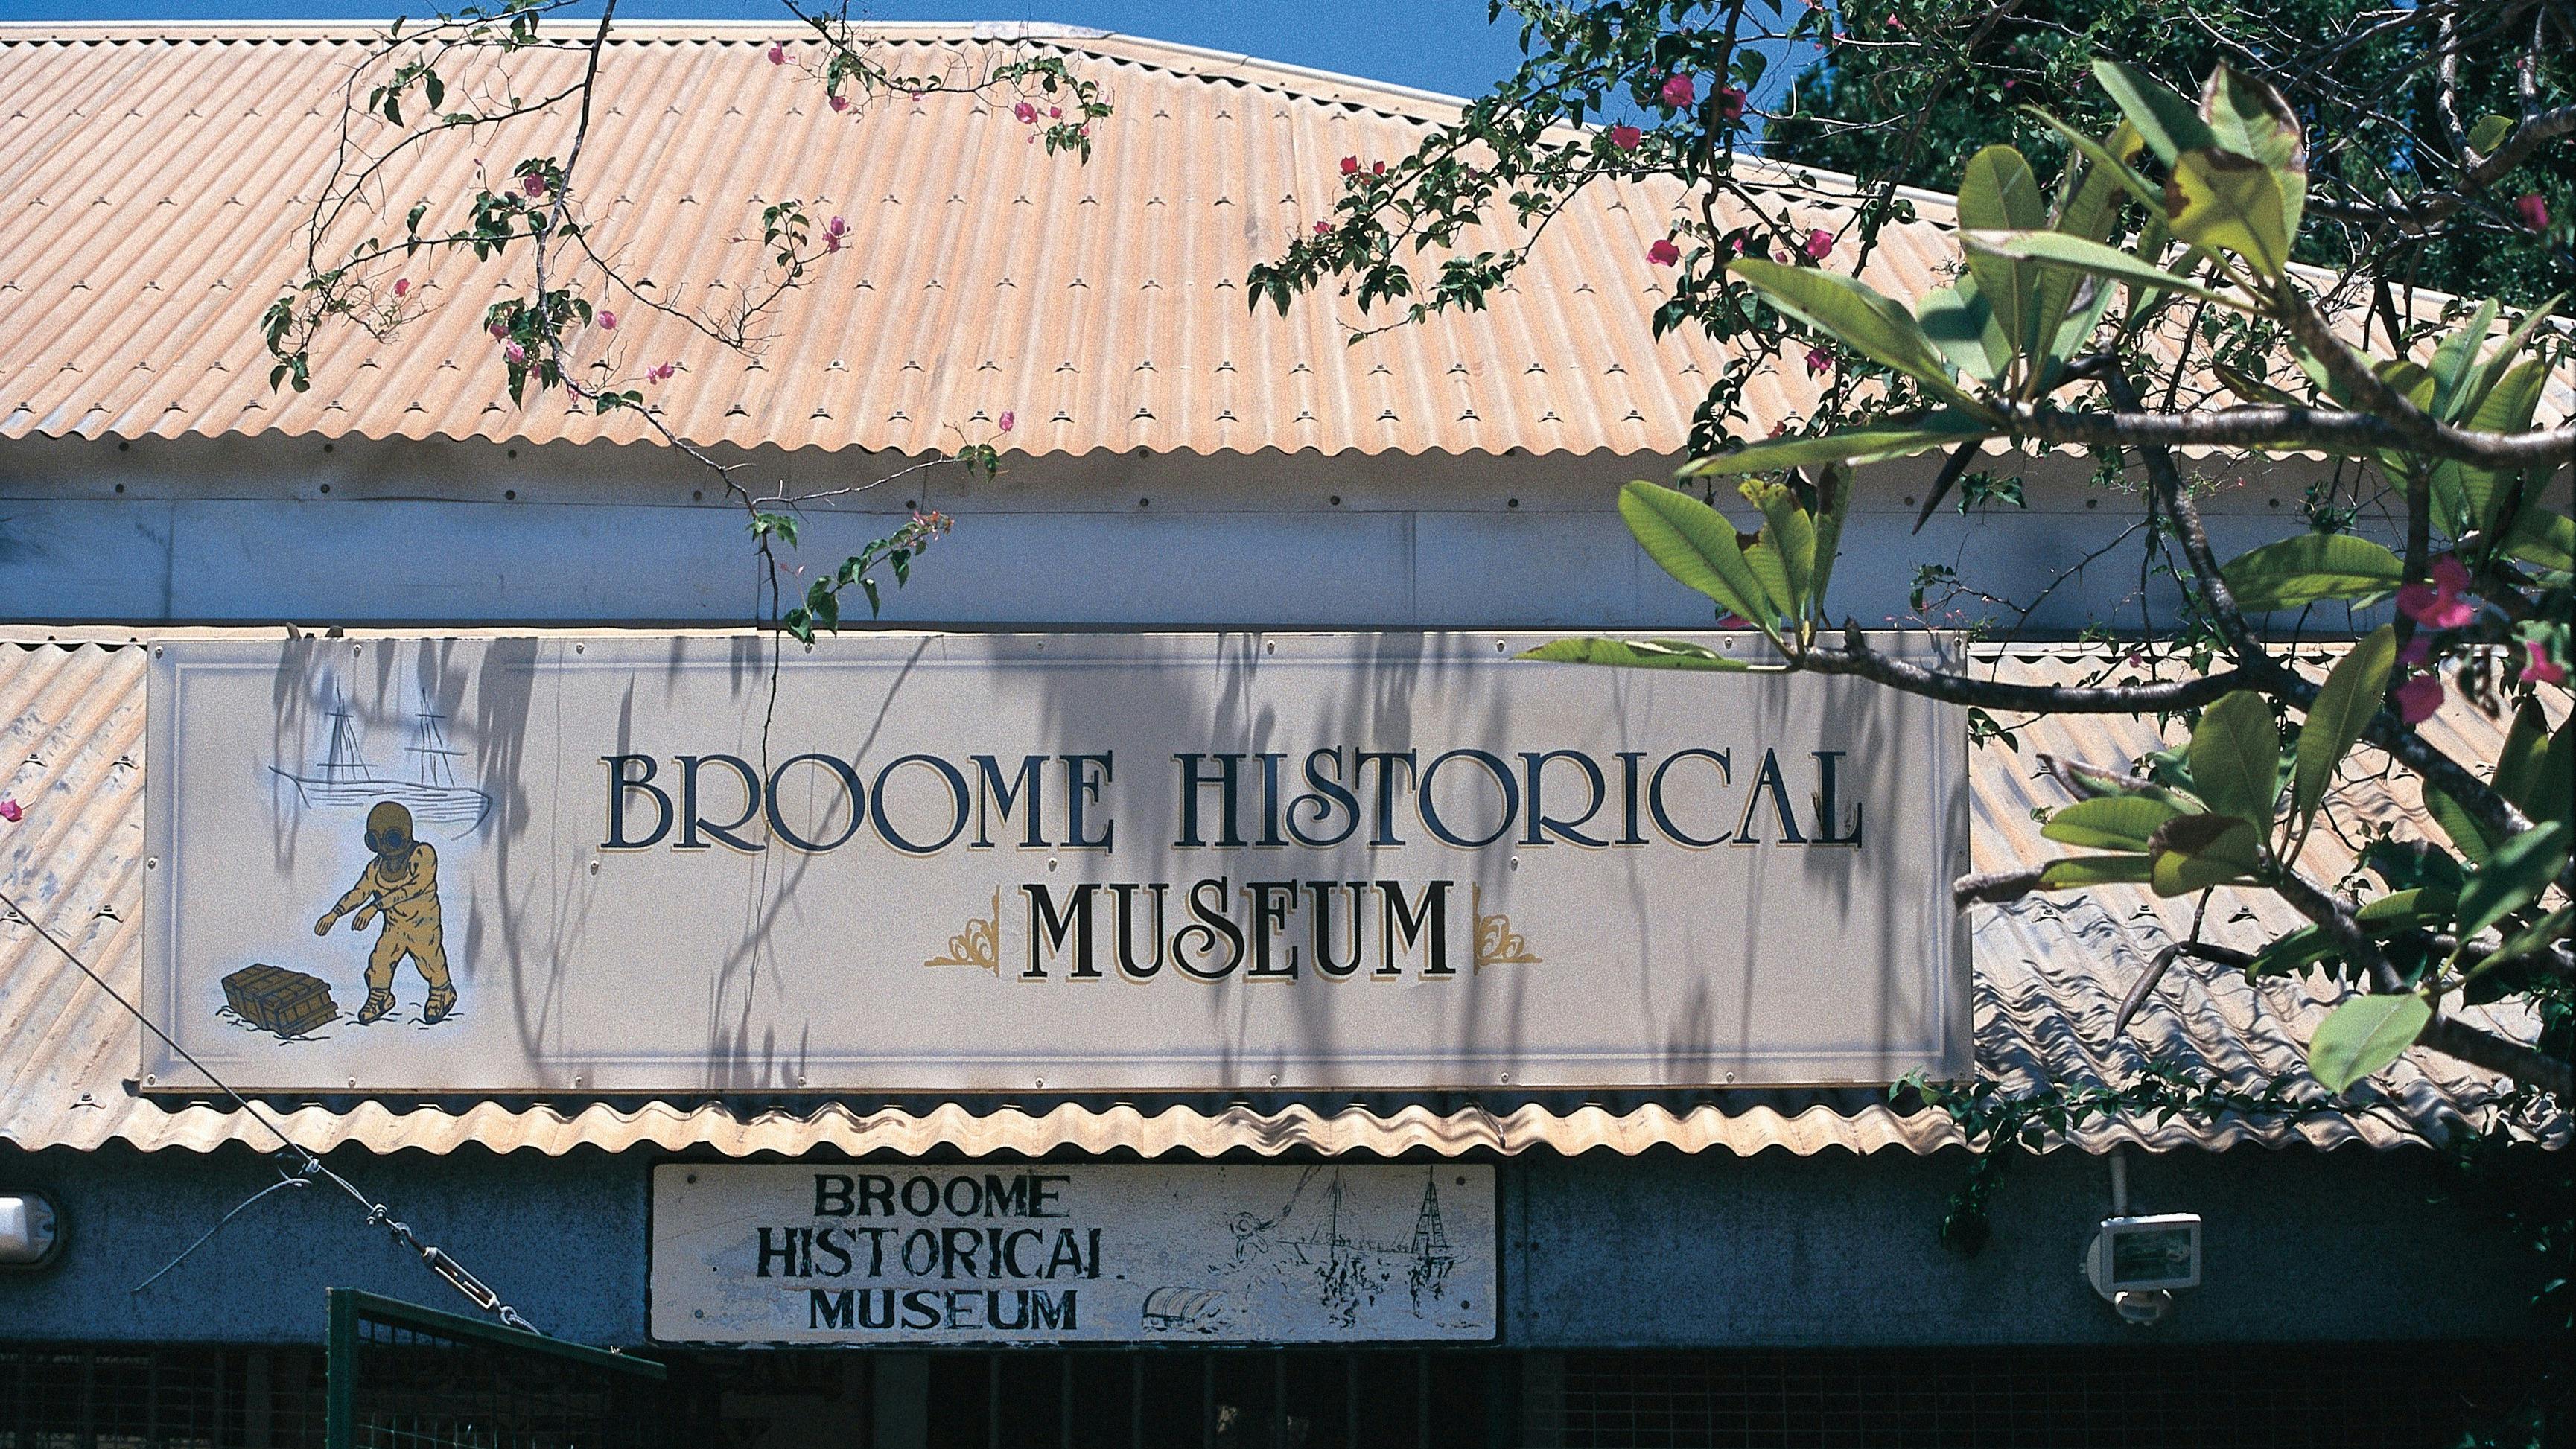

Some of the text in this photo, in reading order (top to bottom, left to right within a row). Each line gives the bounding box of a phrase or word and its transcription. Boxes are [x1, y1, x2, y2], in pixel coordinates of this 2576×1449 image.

[598, 746, 1863, 855] BROOME HISTORICAL
[1018, 876, 1457, 984] MUSEUM
[812, 1173, 1071, 1217] BROOME
[808, 1289, 1078, 1331] MUSEUM
